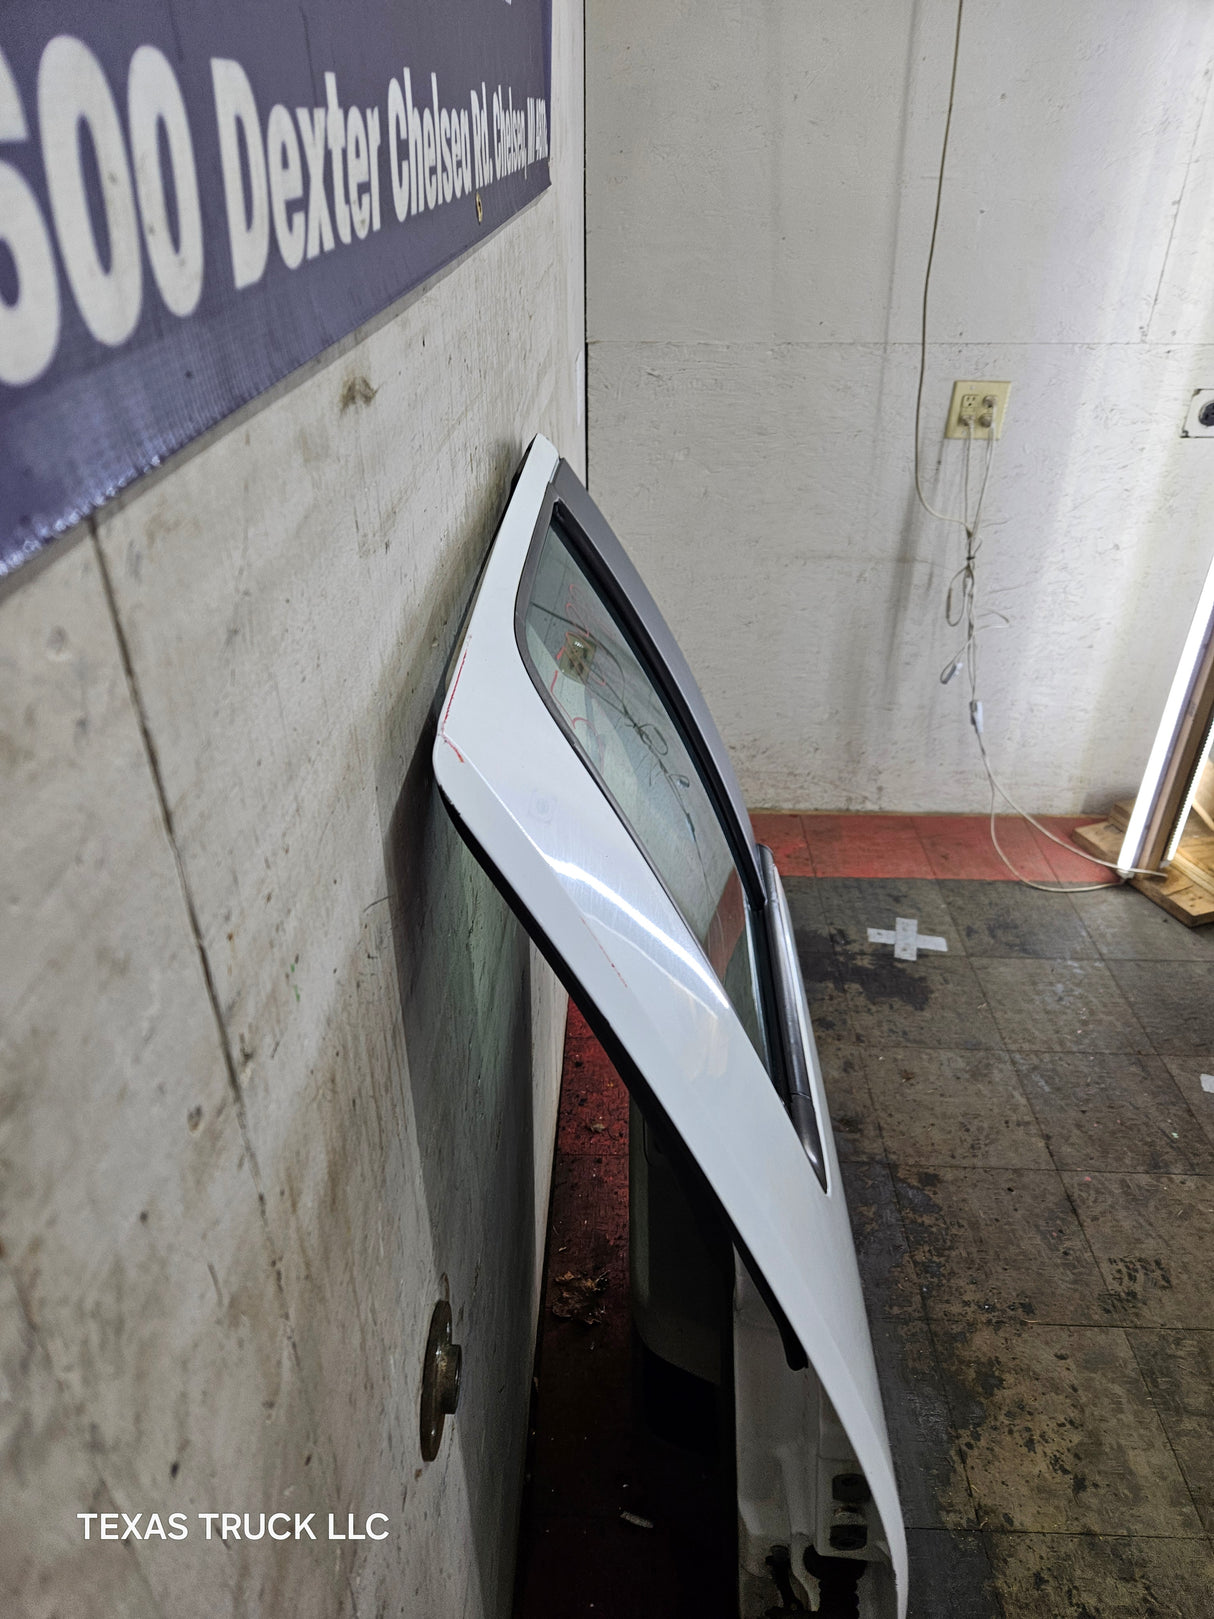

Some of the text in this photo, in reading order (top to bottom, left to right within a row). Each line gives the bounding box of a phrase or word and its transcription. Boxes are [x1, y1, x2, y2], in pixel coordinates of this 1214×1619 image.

[210, 57, 381, 290] Dexter
[388, 67, 472, 222] Chelsea
[470, 81, 493, 189] Rd.
